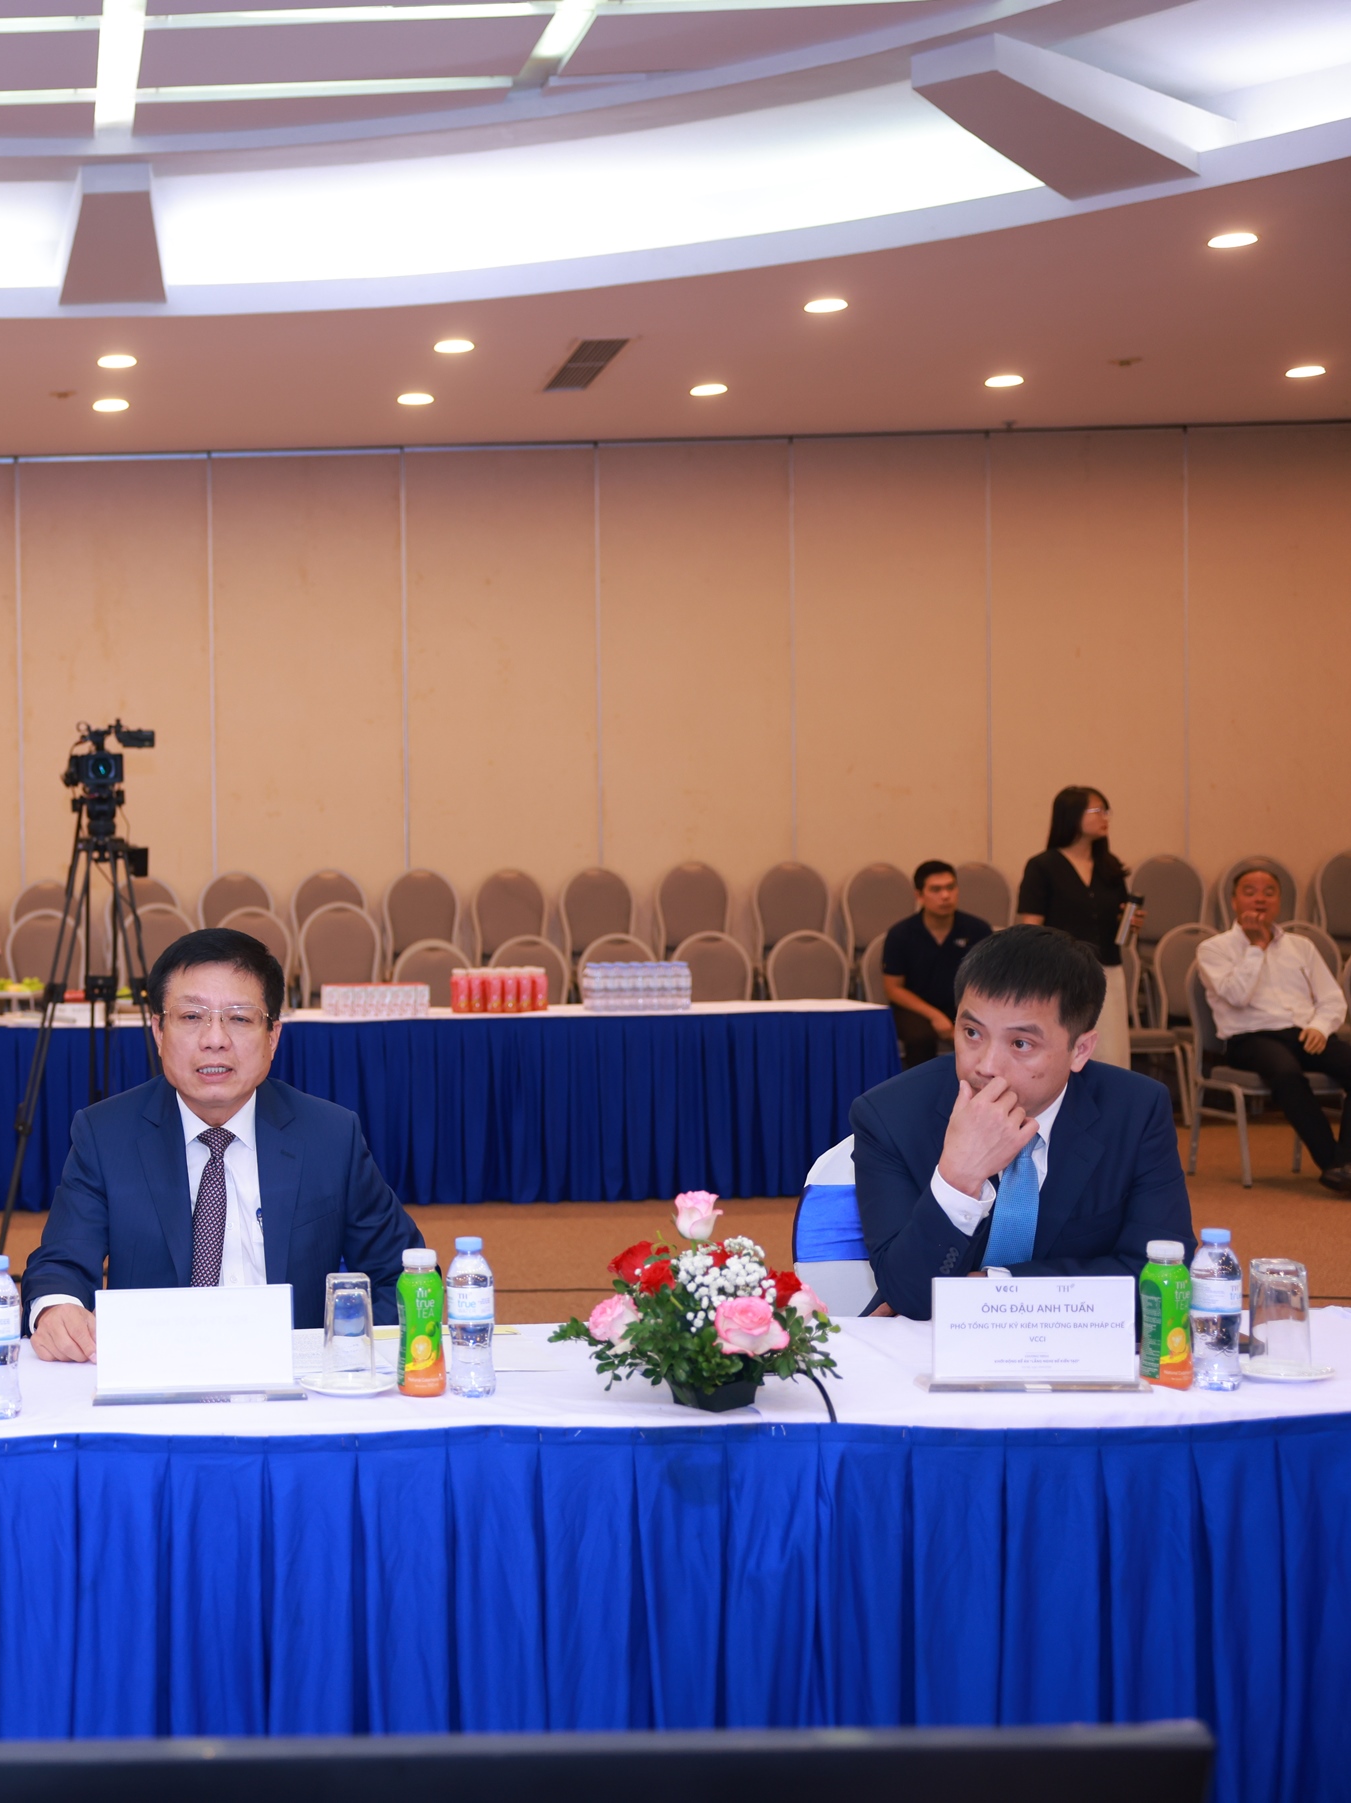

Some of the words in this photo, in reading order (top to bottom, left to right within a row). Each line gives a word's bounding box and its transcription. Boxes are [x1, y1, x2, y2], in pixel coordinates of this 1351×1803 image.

[416, 1299, 435, 1308] true
[457, 1300, 477, 1308] true
[981, 1303, 1007, 1313] ÔNG
[1009, 1302, 1034, 1315] ĐẬU
[1036, 1304, 1061, 1313] ANH
[1063, 1301, 1095, 1313] TUẤN
[416, 1308, 435, 1319] TEA
[1090, 1320, 1109, 1329] PHÁP
